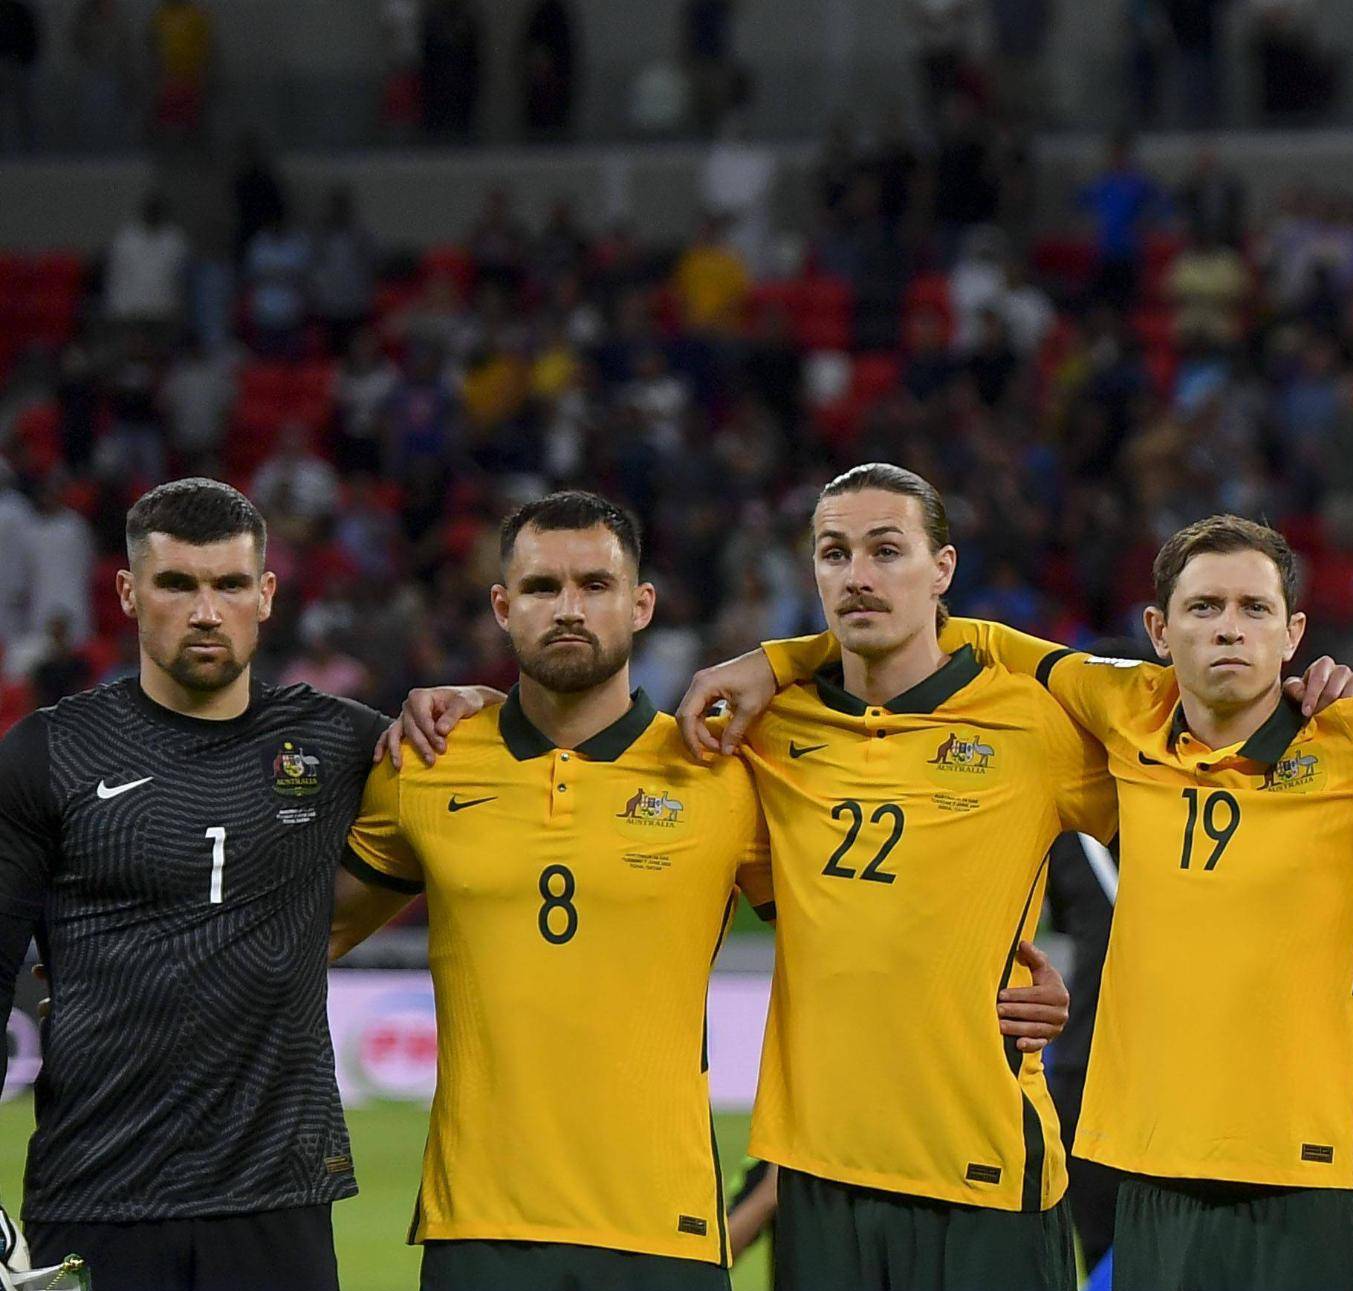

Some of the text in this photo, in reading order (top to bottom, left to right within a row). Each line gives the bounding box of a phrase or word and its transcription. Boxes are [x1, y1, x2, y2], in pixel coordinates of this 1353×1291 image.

[204, 826, 226, 904] 1
[821, 798, 905, 884] 22
[1180, 787, 1241, 871] 19
[538, 864, 578, 945] 8
